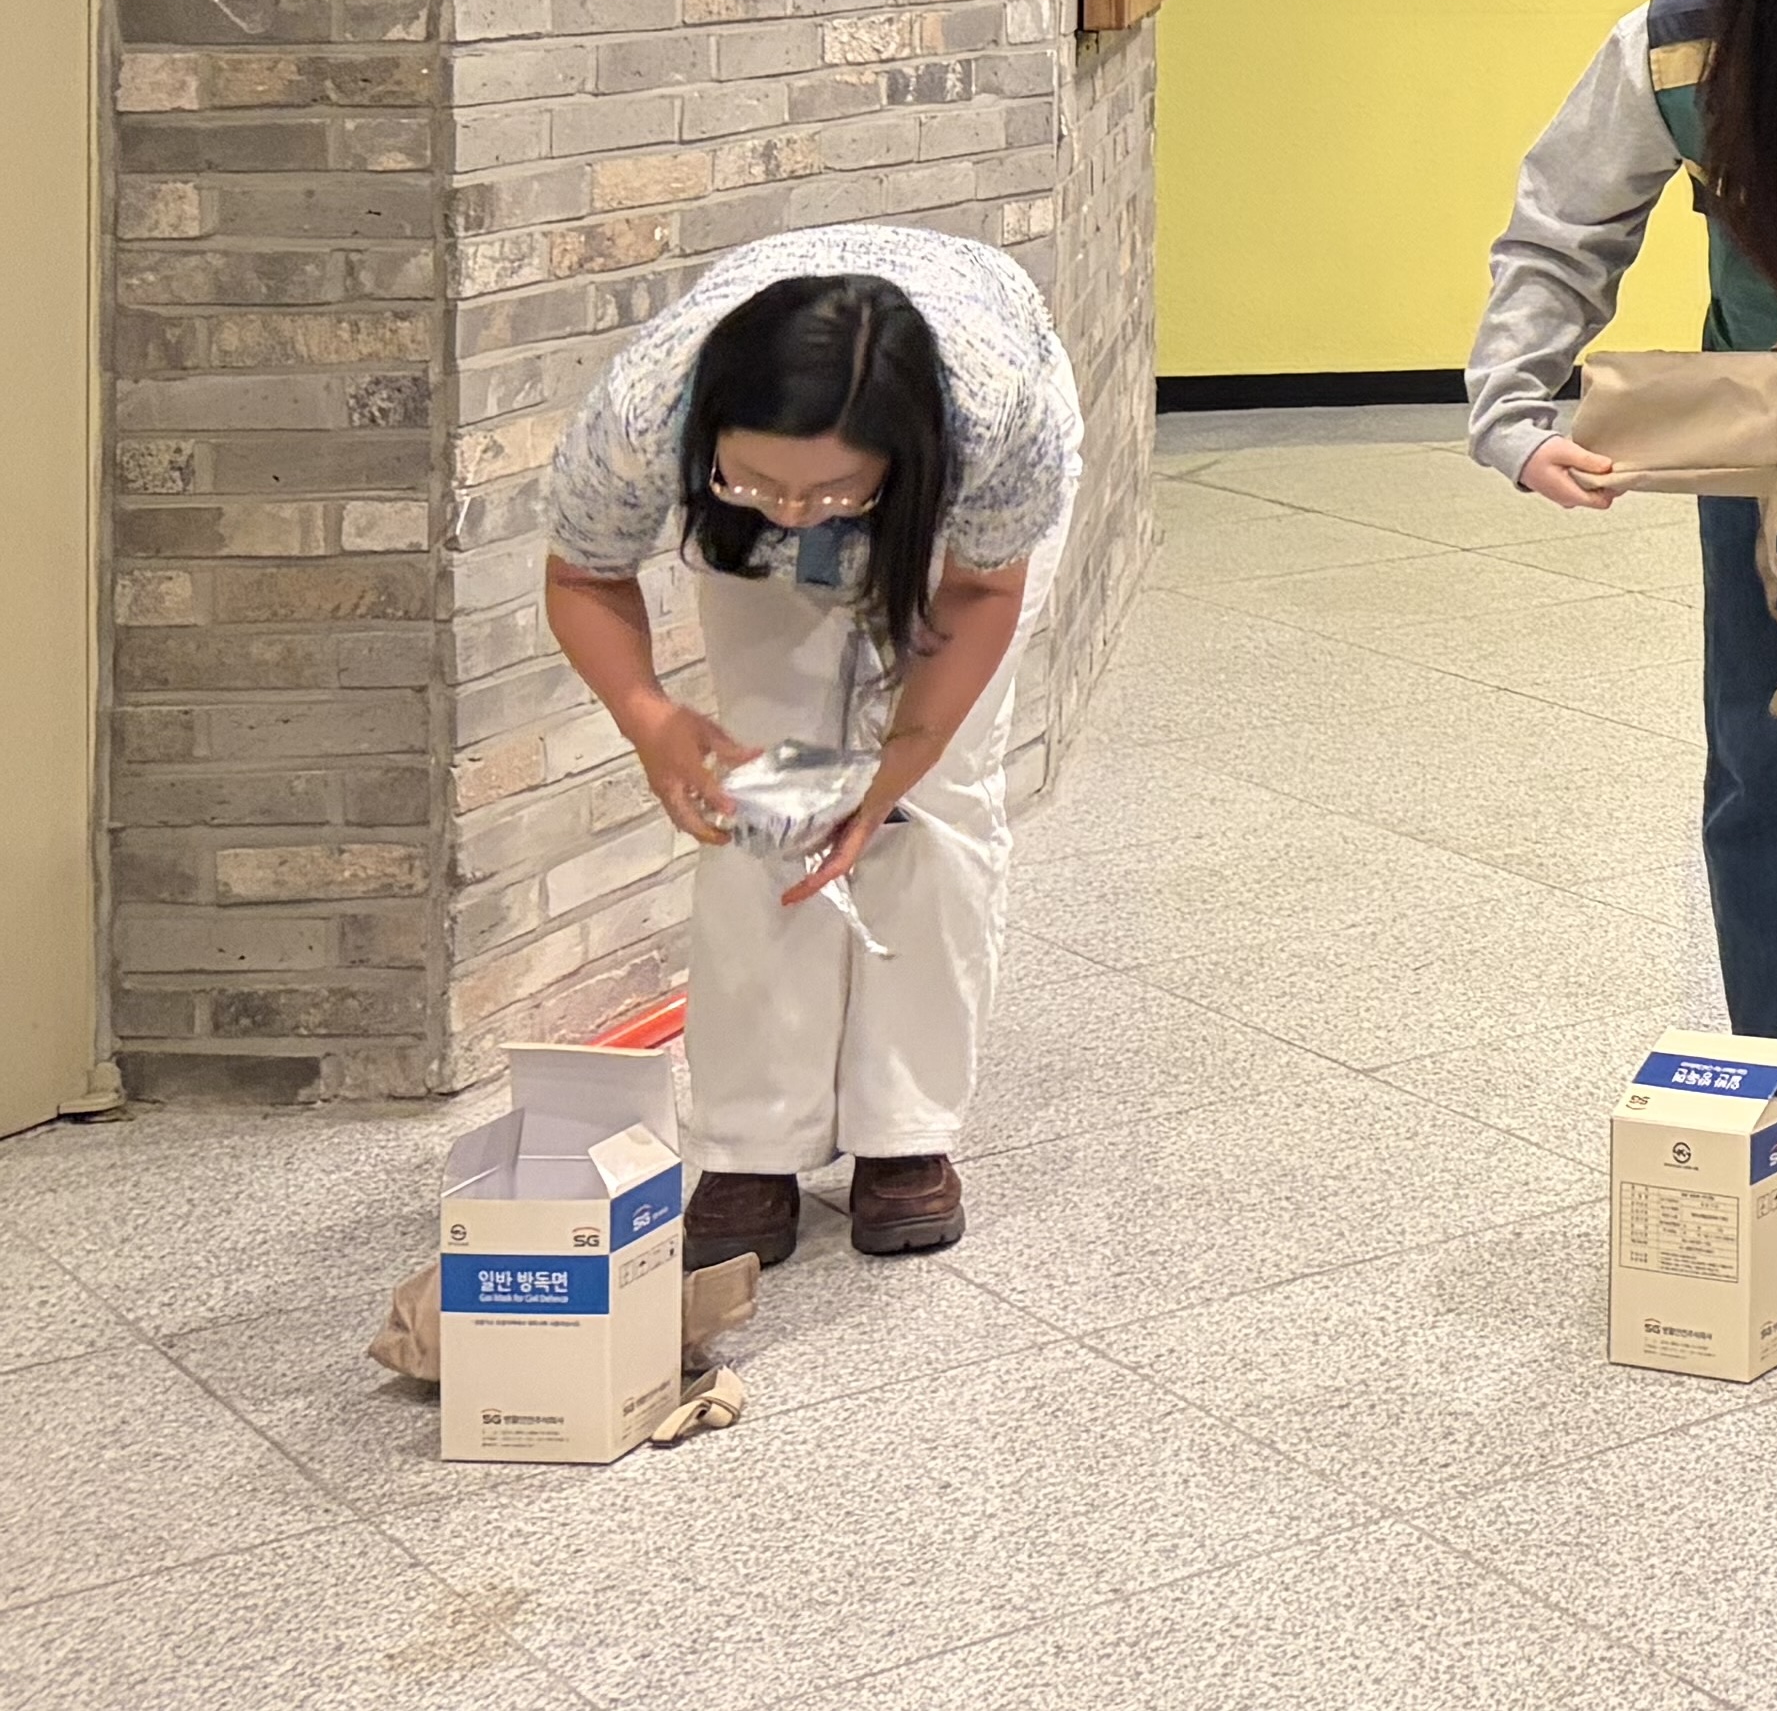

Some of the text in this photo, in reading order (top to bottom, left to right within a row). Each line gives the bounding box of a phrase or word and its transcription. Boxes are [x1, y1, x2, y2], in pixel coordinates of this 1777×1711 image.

[1671, 1067, 1713, 1087] 방독면
[1713, 1073, 1743, 1090] 일반
[573, 1234, 600, 1248] SG
[478, 1270, 569, 1294] 일반 방독면
